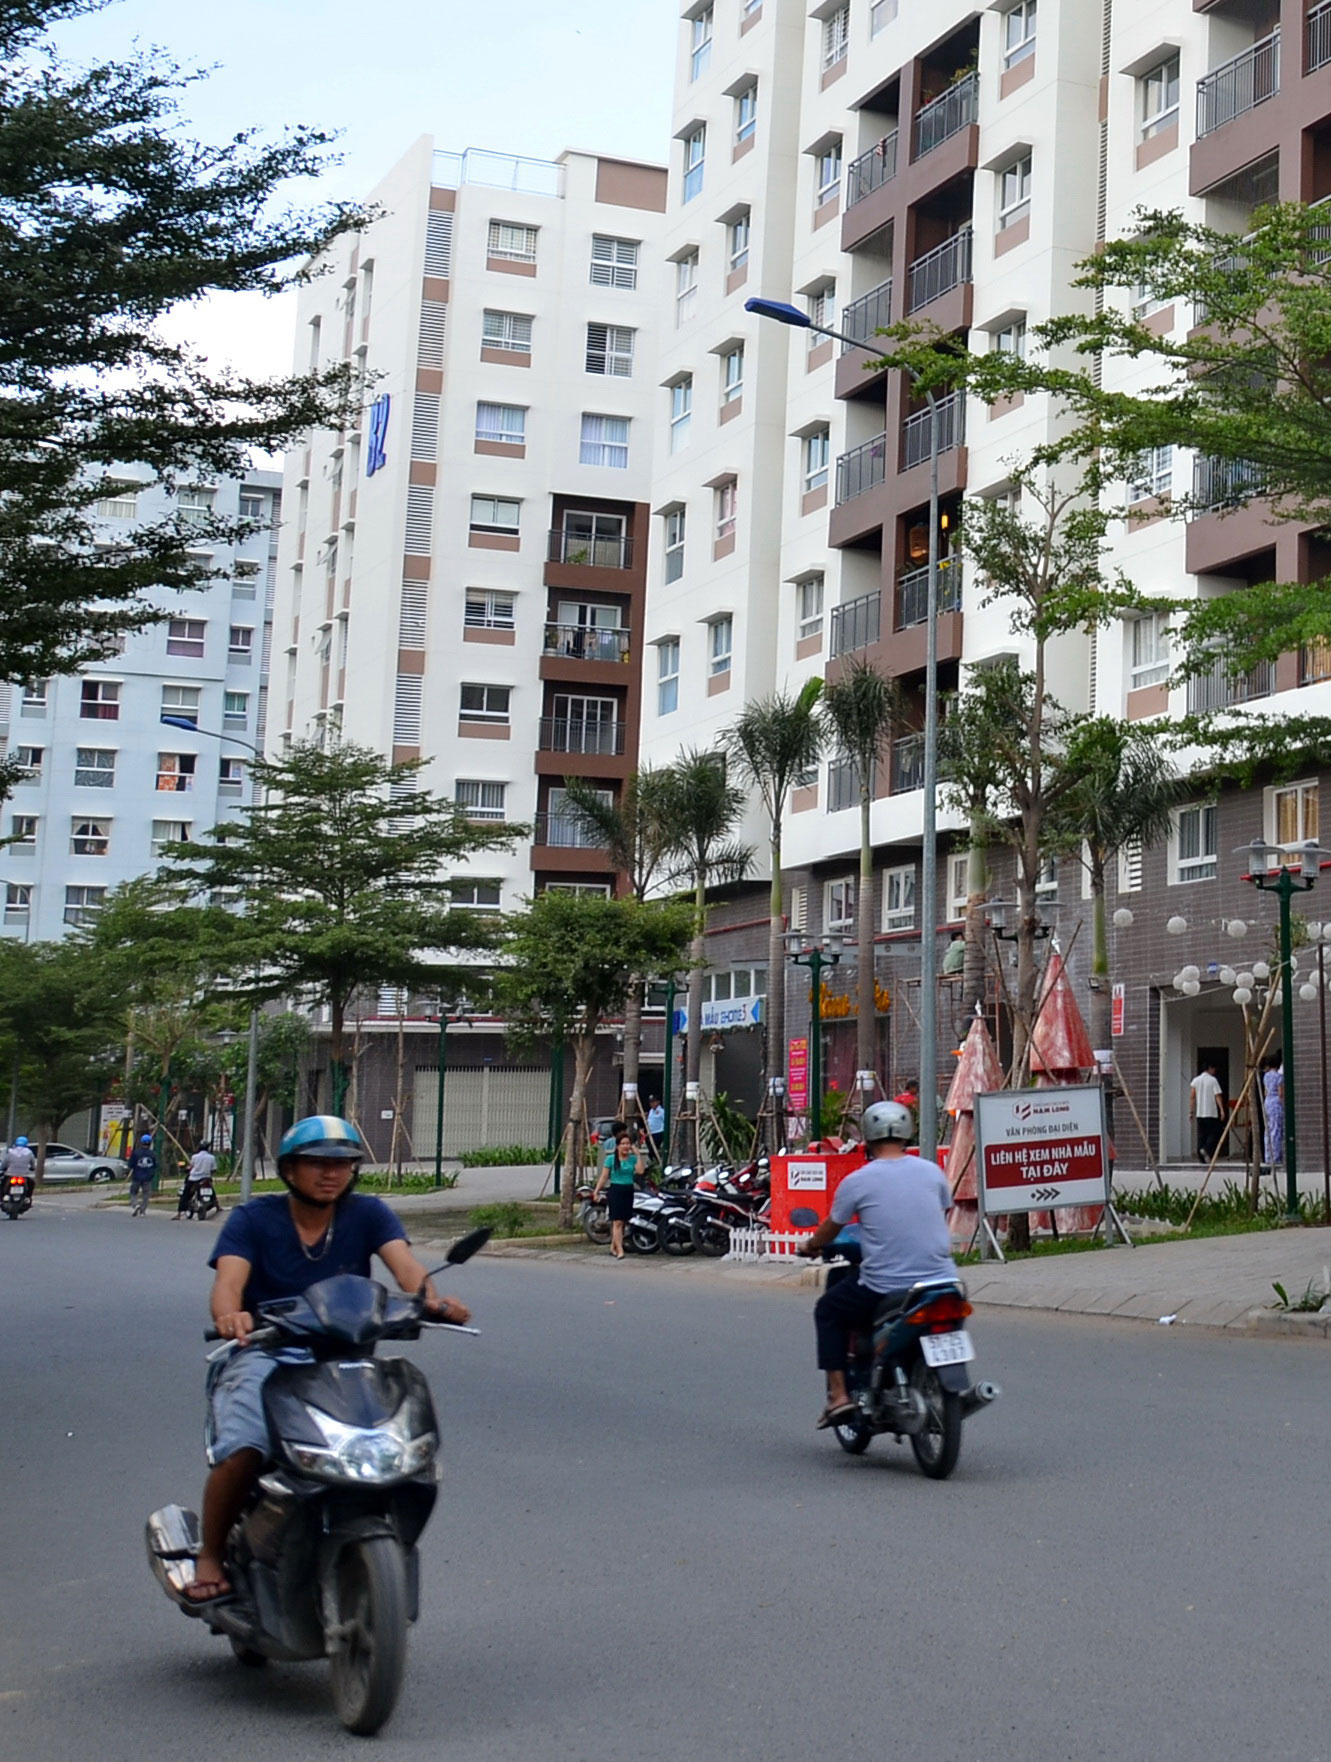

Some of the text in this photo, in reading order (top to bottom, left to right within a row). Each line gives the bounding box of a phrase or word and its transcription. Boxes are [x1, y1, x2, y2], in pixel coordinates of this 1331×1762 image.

[1033, 1105, 1070, 1114] NAM LONG
[991, 1140, 1096, 1166] LIÊN HỆ XEM NHÀ MẪU
[1020, 1161, 1069, 1182] TẠI ĐÂY
